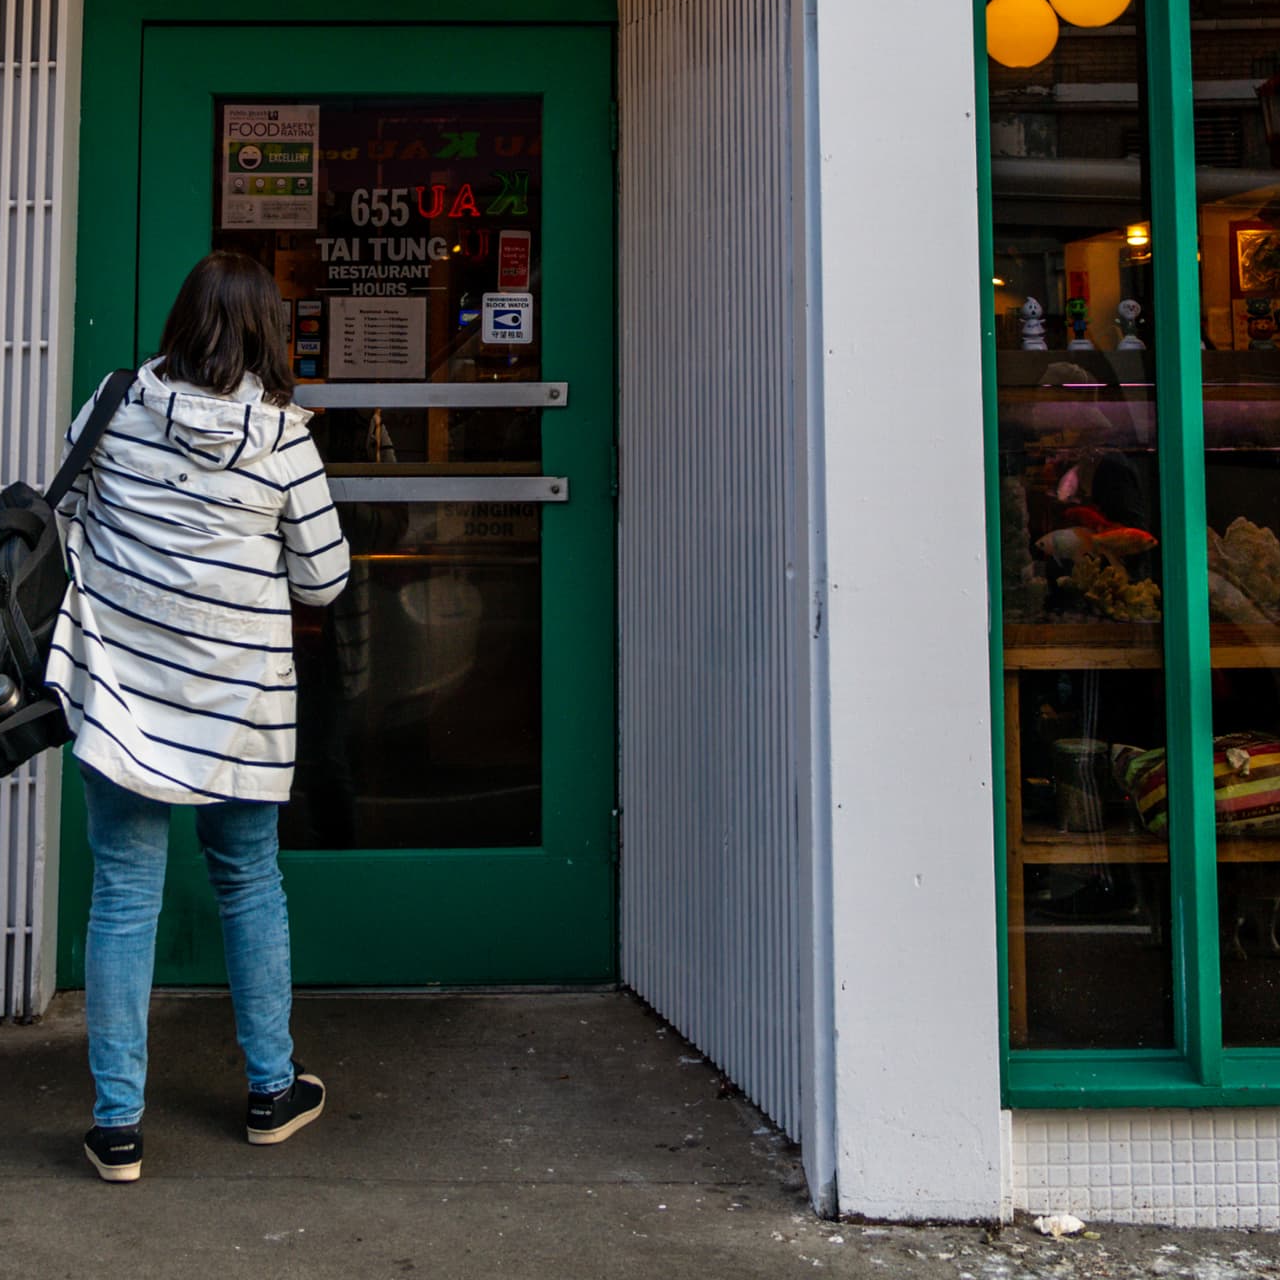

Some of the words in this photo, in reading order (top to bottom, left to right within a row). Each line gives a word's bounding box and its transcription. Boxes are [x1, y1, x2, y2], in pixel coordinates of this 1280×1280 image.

[228, 122, 280, 137] FOOD
[280, 129, 315, 137] RATING
[268, 152, 310, 163] EXCELLENT
[350, 187, 410, 227] 655
[316, 237, 360, 261] TAI
[368, 236, 449, 262] TUNG
[328, 265, 432, 280] RESTAURANT
[351, 282, 408, 296] HOURS
[446, 503, 534, 517] SWINGING
[464, 521, 514, 537] DOOR
